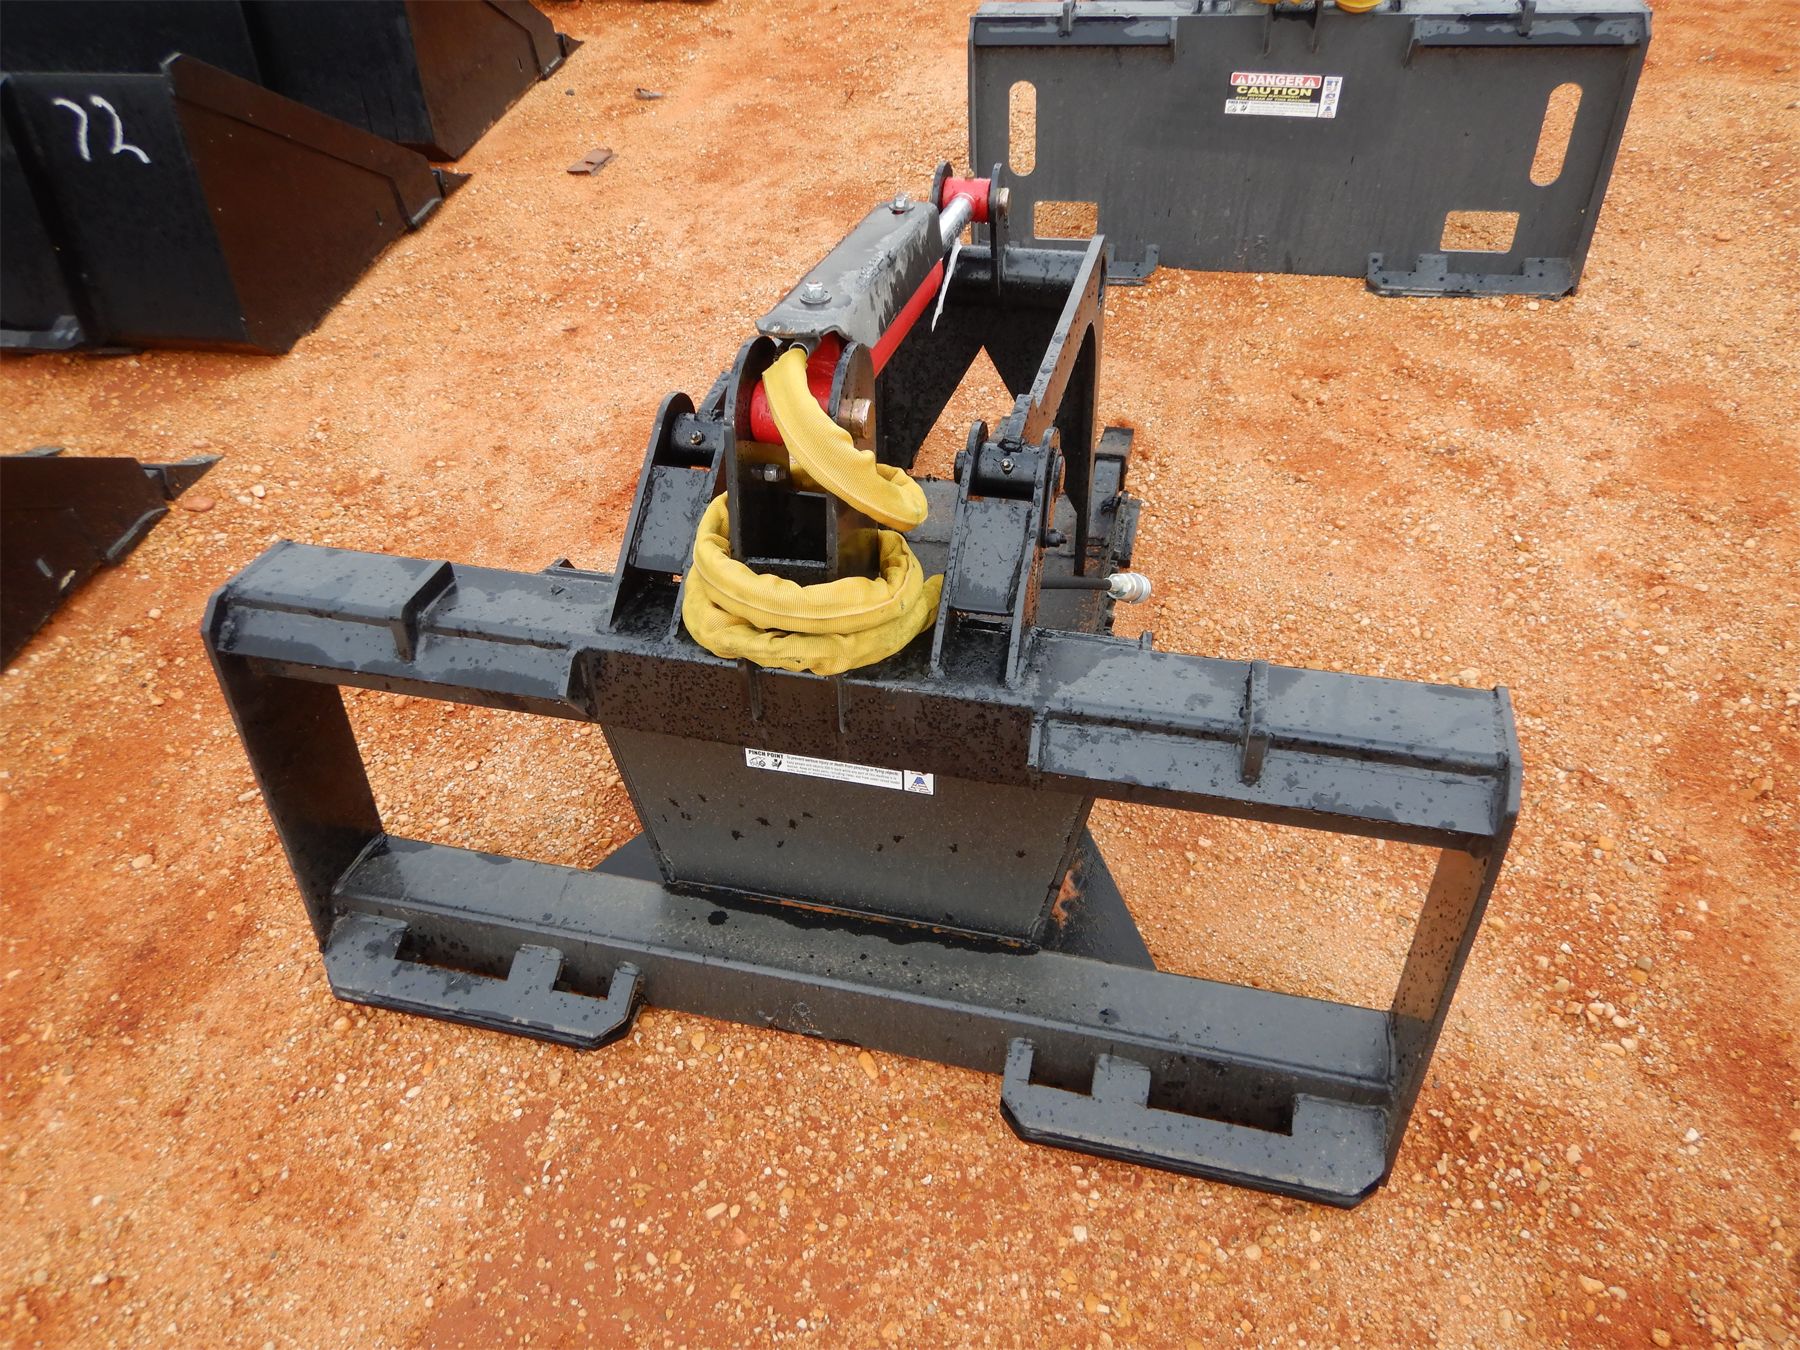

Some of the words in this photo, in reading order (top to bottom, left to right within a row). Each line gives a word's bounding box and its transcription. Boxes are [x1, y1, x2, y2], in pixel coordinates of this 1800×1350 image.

[1247, 75, 1304, 87] DANGER
[1236, 86, 1313, 97] CAUTION
[51, 94, 152, 164] 72
